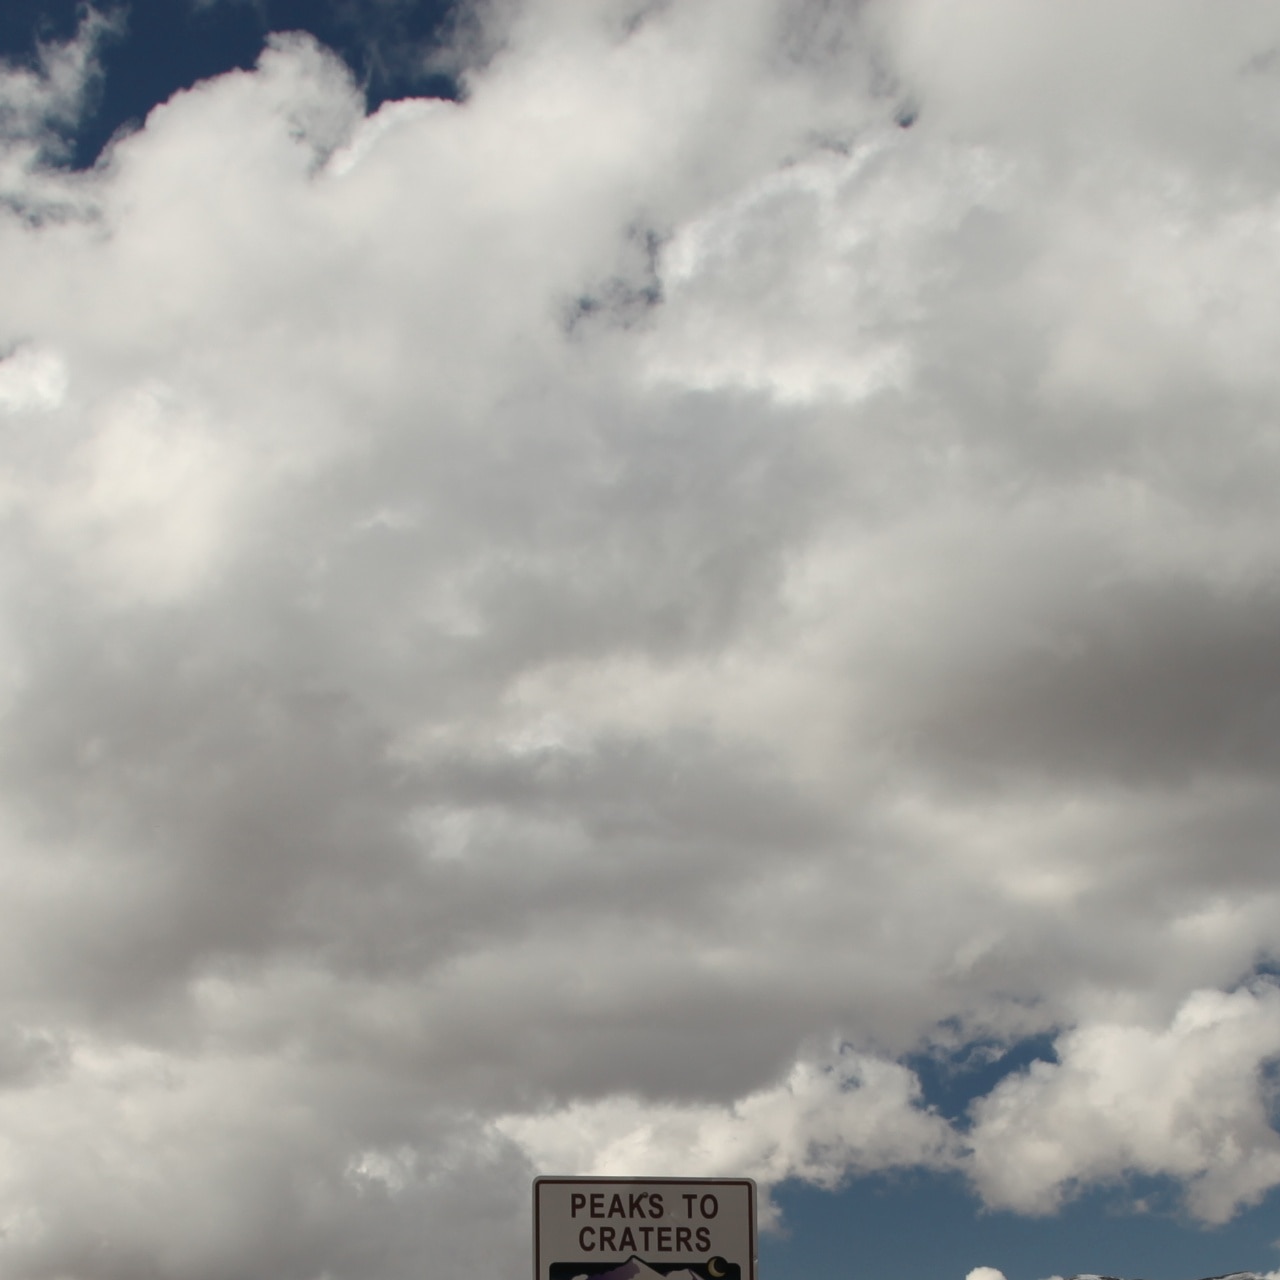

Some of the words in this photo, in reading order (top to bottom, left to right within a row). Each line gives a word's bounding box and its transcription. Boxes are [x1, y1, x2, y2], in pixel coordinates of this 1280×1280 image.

[570, 1193, 664, 1219] PEAKS
[682, 1193, 719, 1219] TO
[578, 1226, 711, 1252] CRATERS
